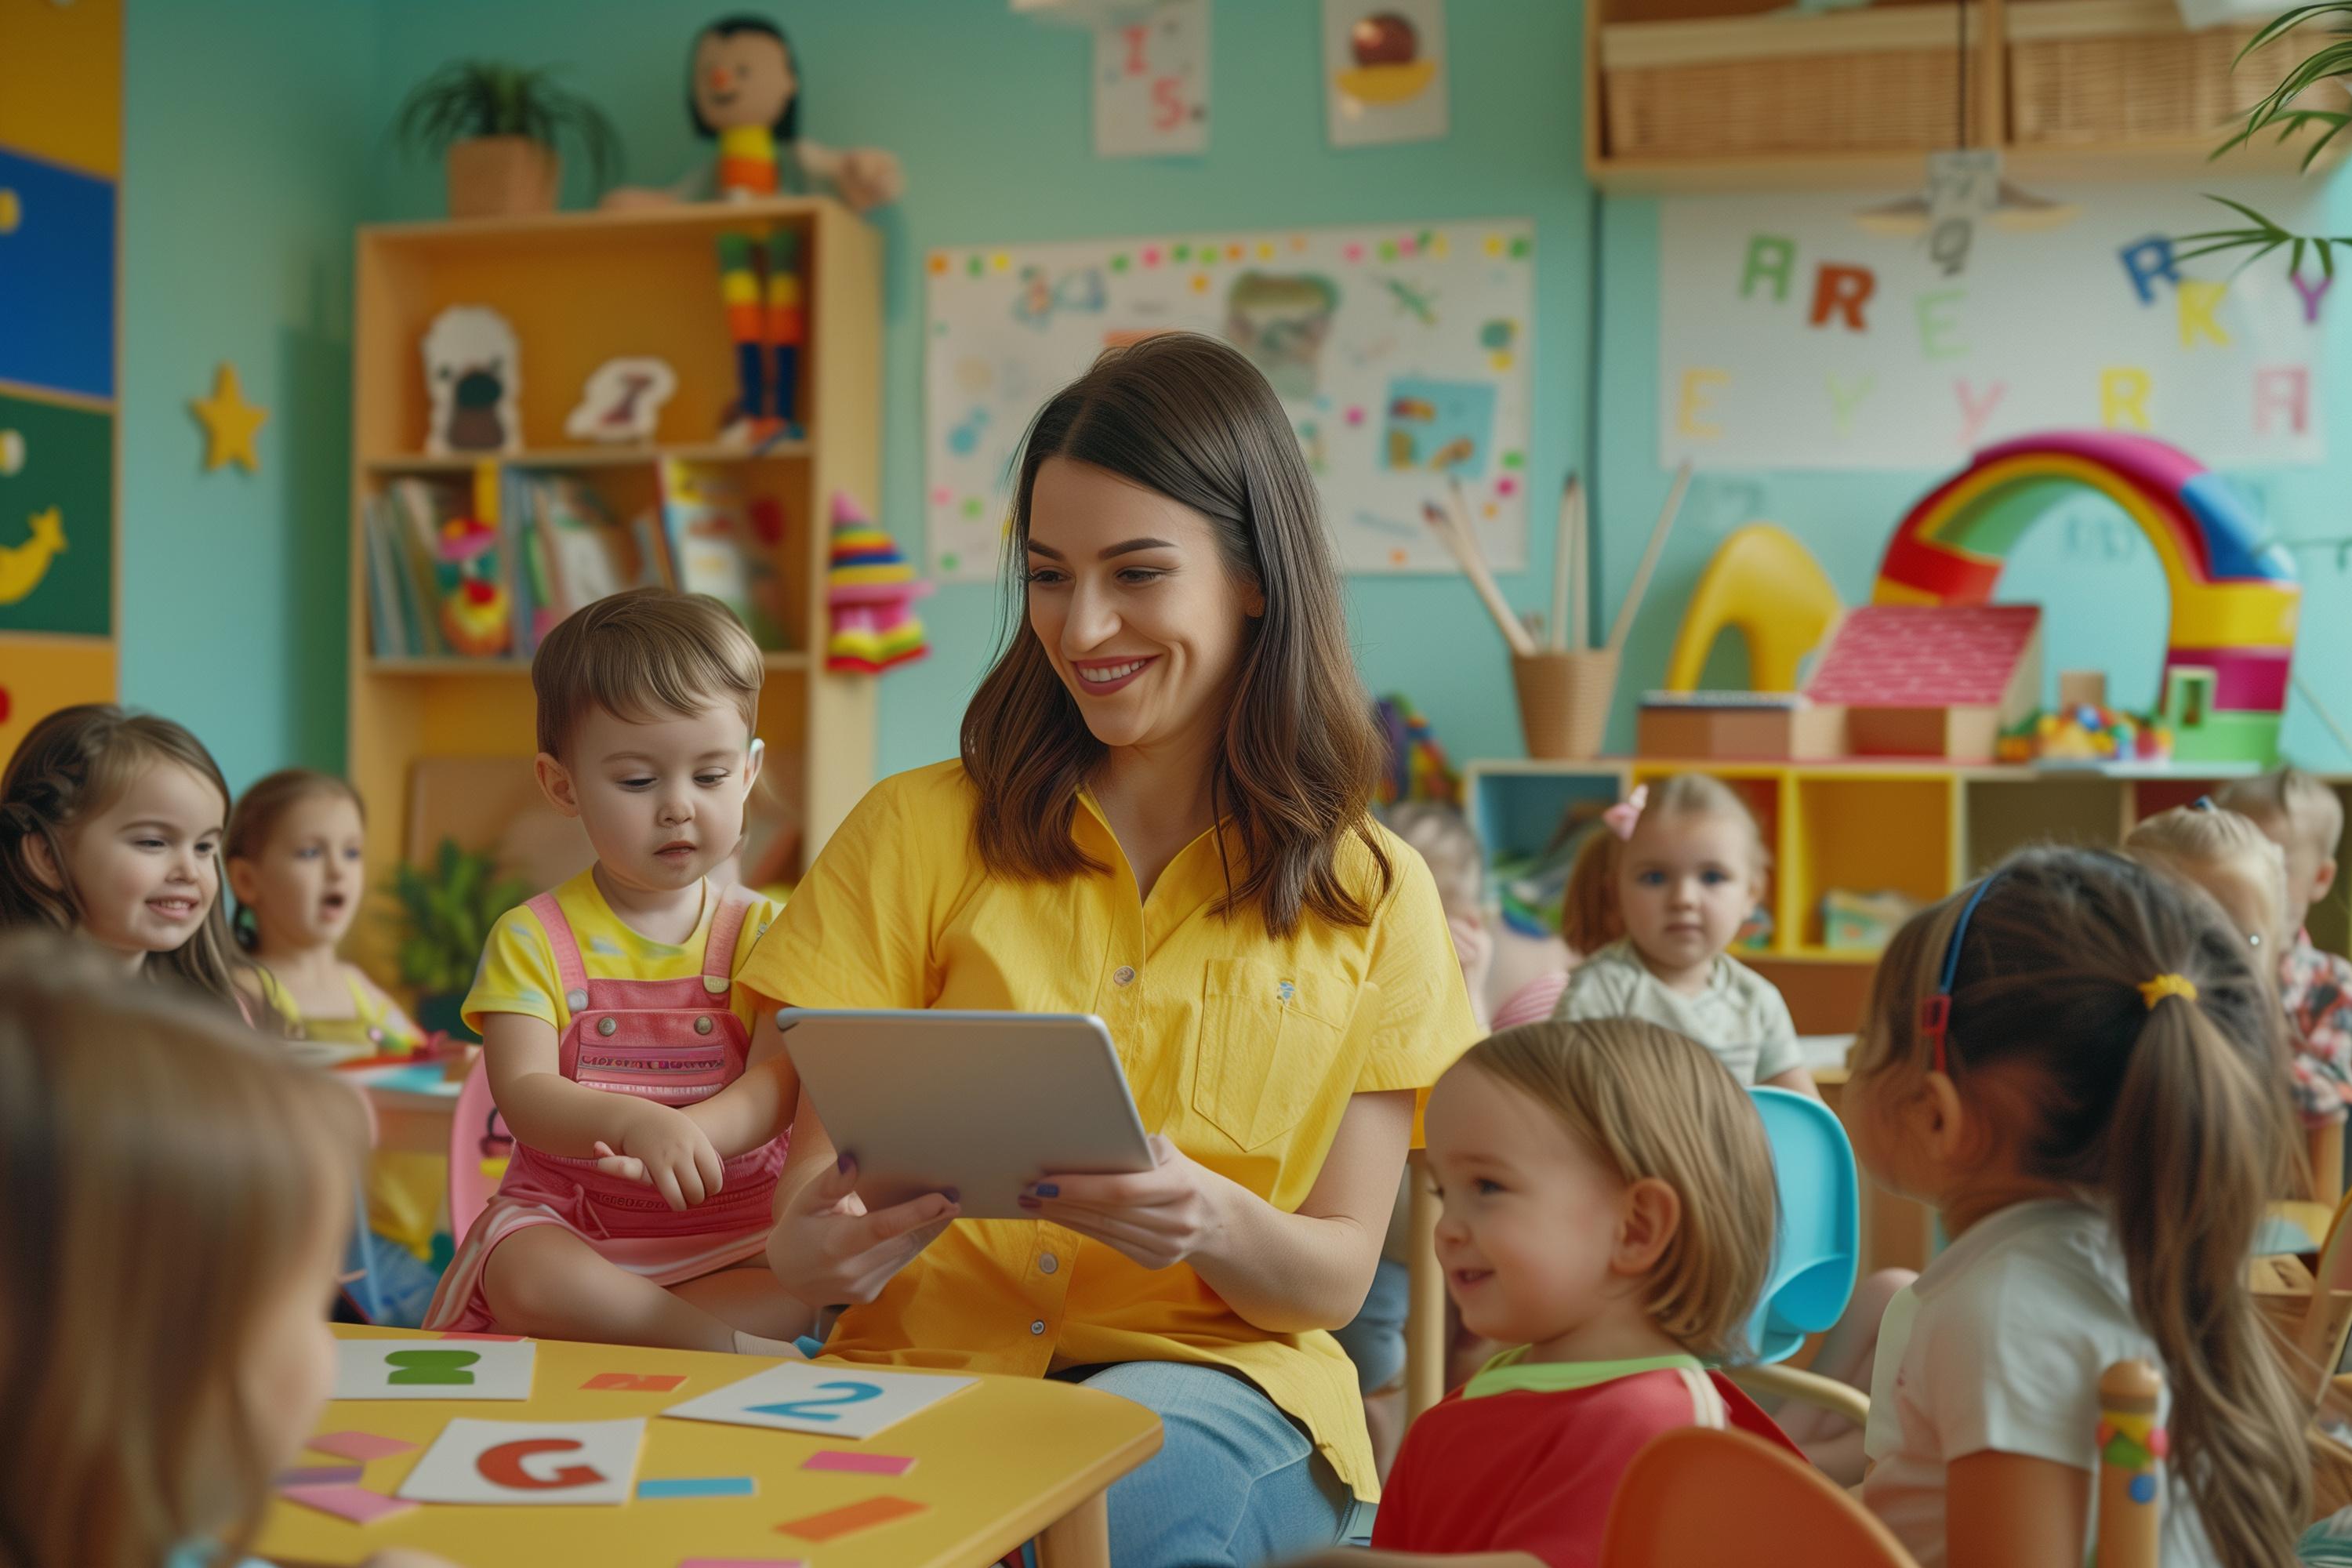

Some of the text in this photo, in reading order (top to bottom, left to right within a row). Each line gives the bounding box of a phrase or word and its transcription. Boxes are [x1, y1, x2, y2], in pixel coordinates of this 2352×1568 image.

[1808, 261, 1876, 332] R
[2118, 234, 2184, 306] R
[2175, 277, 2231, 350] K
[1678, 368, 1729, 437] E
[2097, 365, 2153, 432] R
[740, 1380, 884, 1423] 2
[474, 1437, 611, 1494] G
